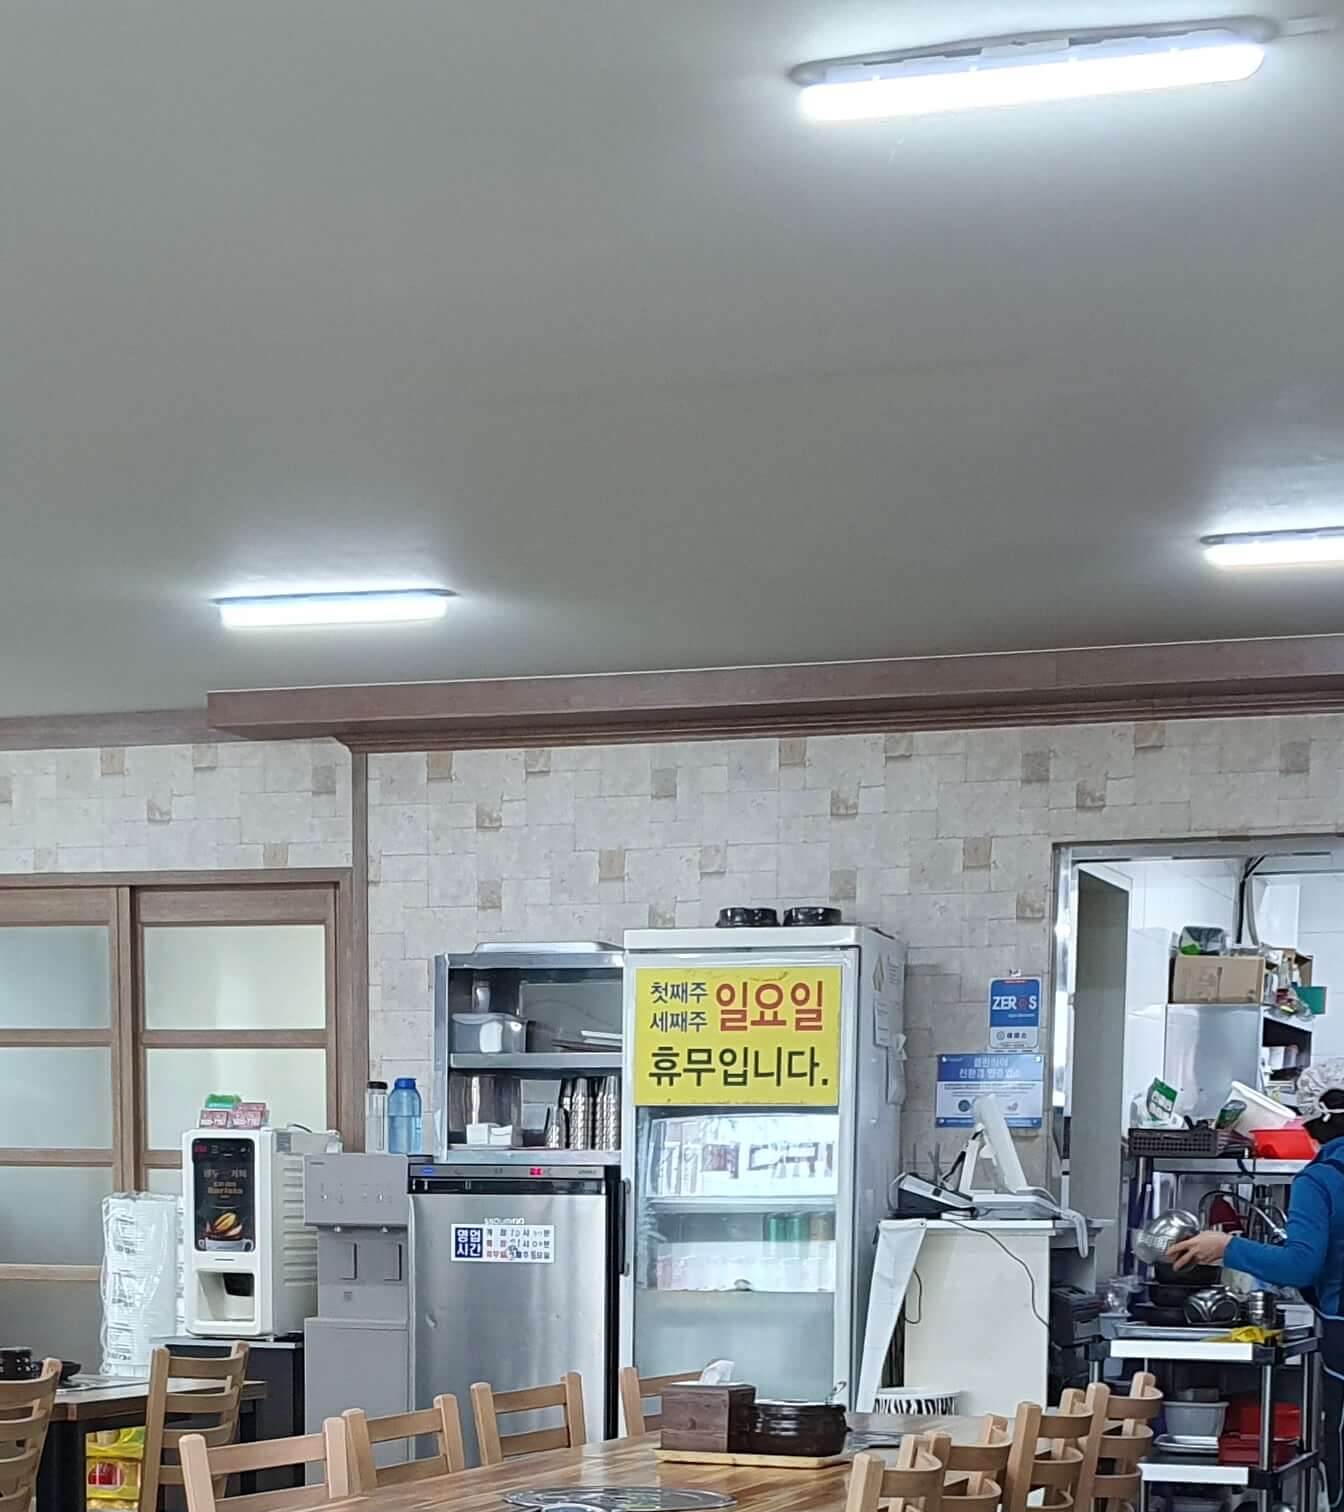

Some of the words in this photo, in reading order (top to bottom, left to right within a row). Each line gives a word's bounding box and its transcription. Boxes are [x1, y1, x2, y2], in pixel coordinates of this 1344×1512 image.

[650, 981, 708, 1004] 첫째주
[715, 980, 824, 1032] 일요일
[649, 1011, 708, 1033] 세째주
[648, 1046, 829, 1087] 휴무입니다.
[456, 1229, 481, 1243] 영업
[456, 1243, 481, 1257] 시간
